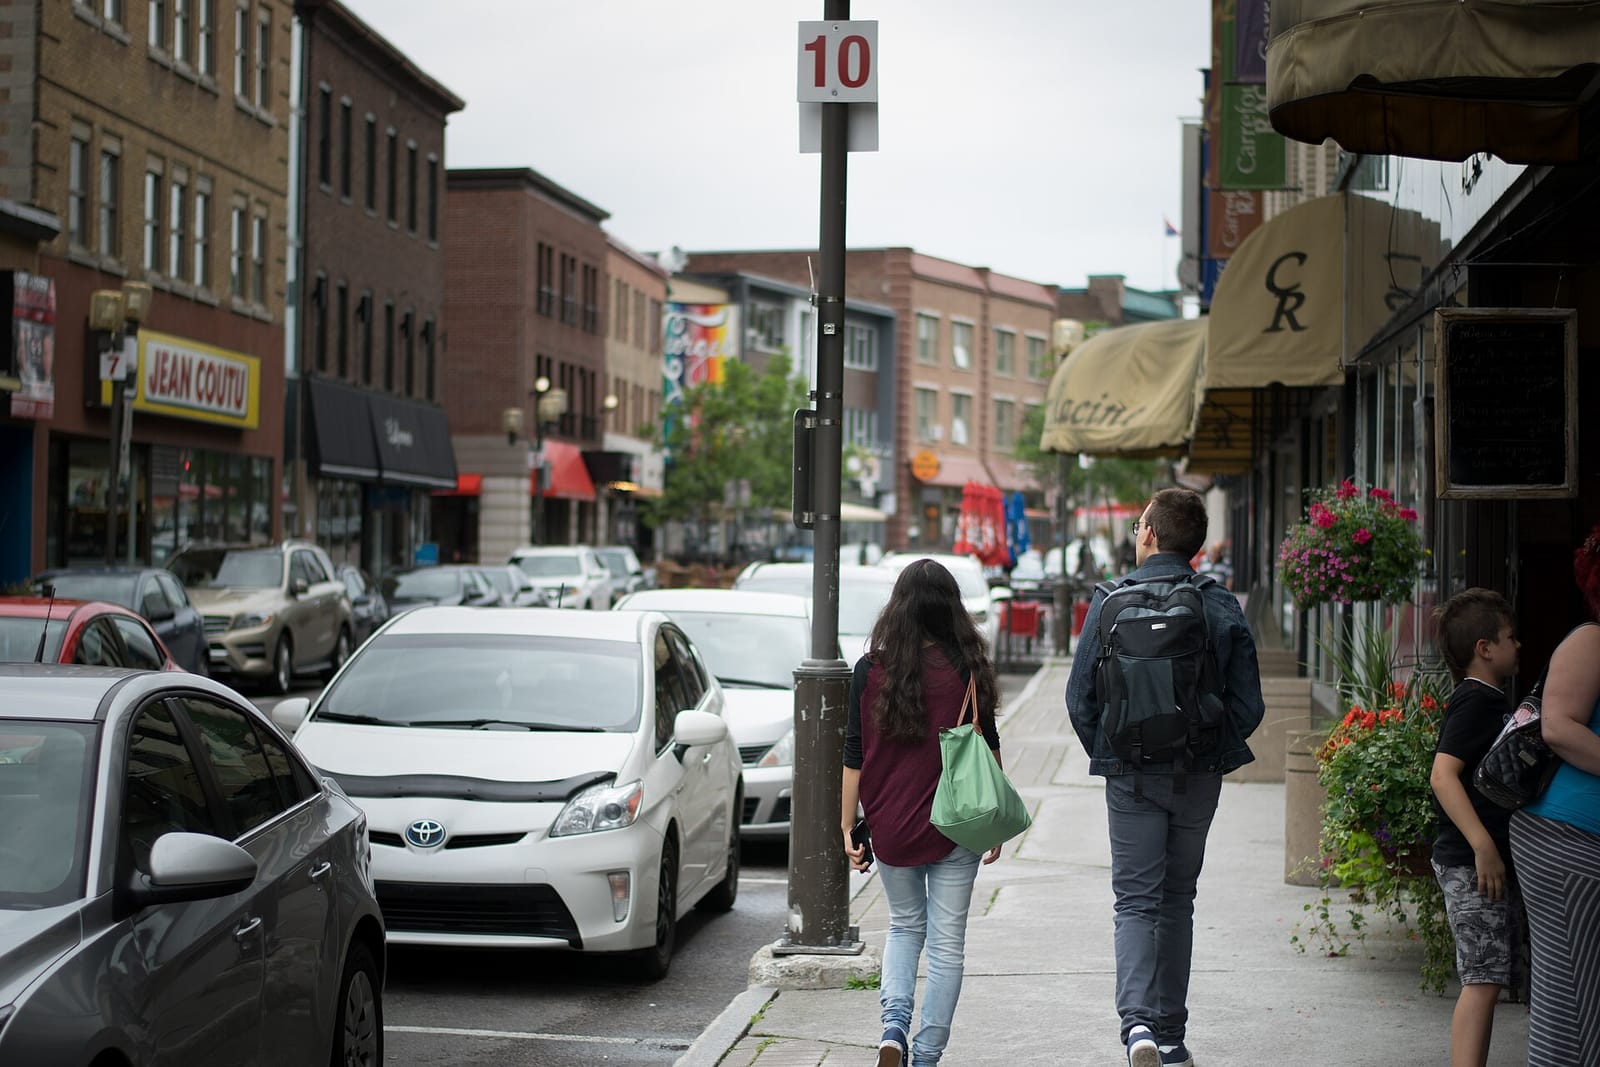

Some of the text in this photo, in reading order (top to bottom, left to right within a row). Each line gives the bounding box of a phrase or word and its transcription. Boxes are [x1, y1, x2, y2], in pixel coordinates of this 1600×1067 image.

[804, 34, 870, 88] 10
[107, 355, 120, 376] 7
[148, 349, 247, 410] JEAN COUTU
